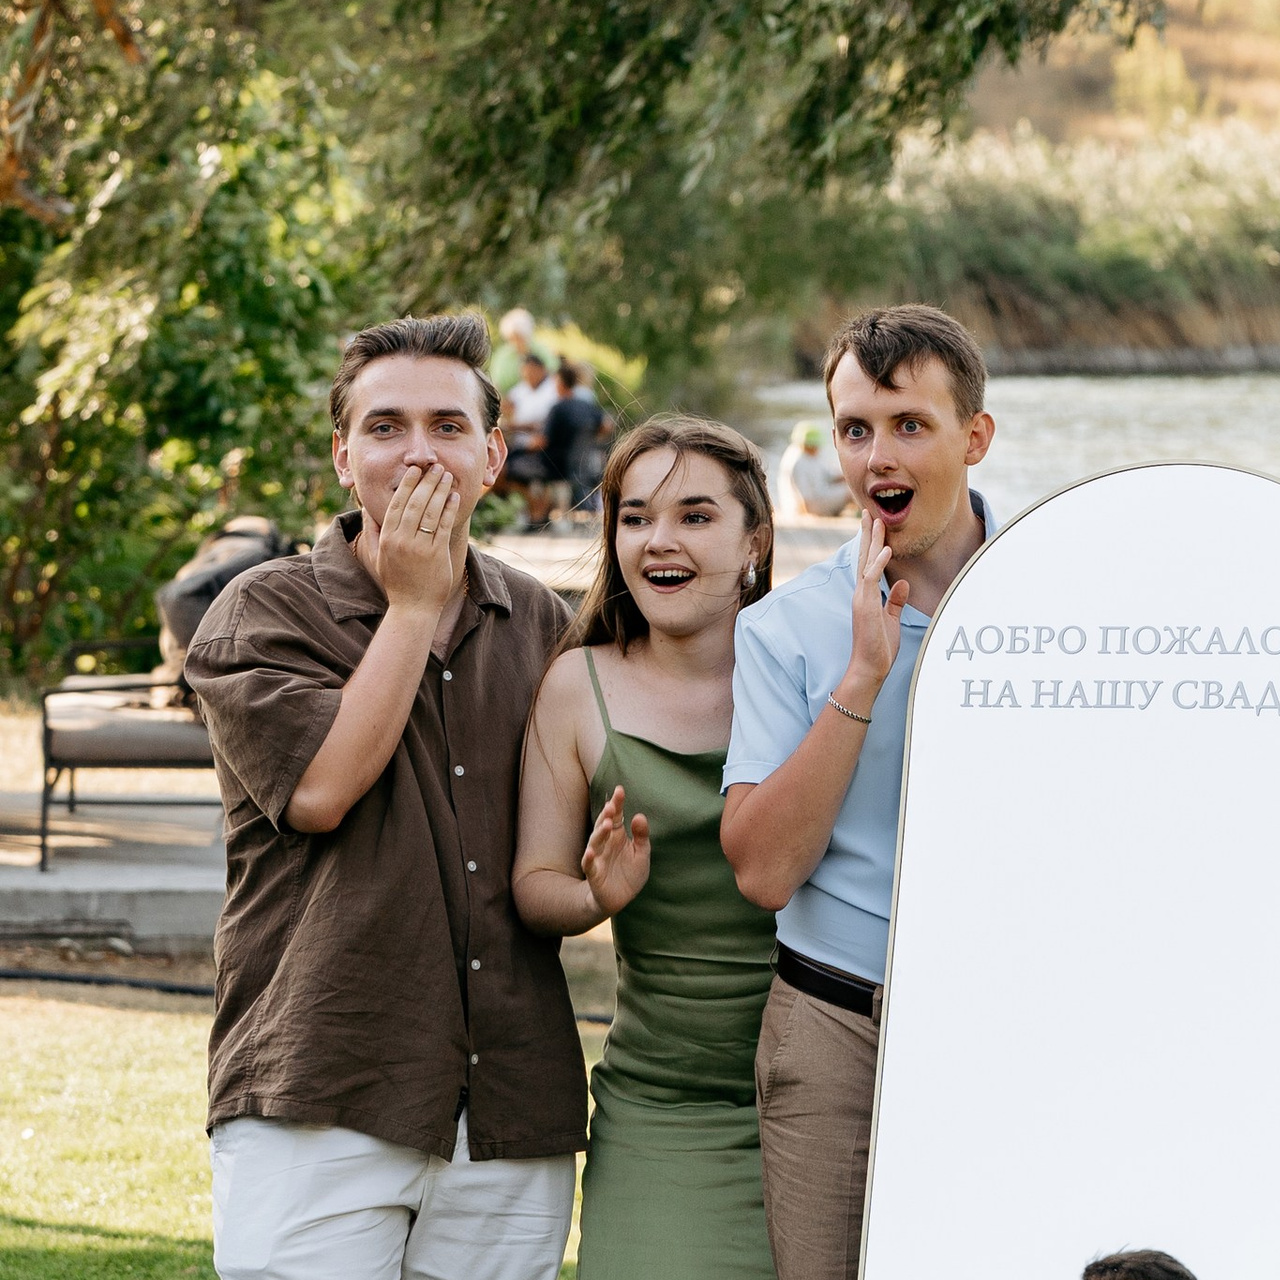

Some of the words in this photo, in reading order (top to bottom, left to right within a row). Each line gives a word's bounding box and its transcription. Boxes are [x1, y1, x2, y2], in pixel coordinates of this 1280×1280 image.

[946, 624, 1087, 661] ДОБРО
[960, 678, 1020, 709] НА
[1030, 679, 1163, 710] НАШУ
